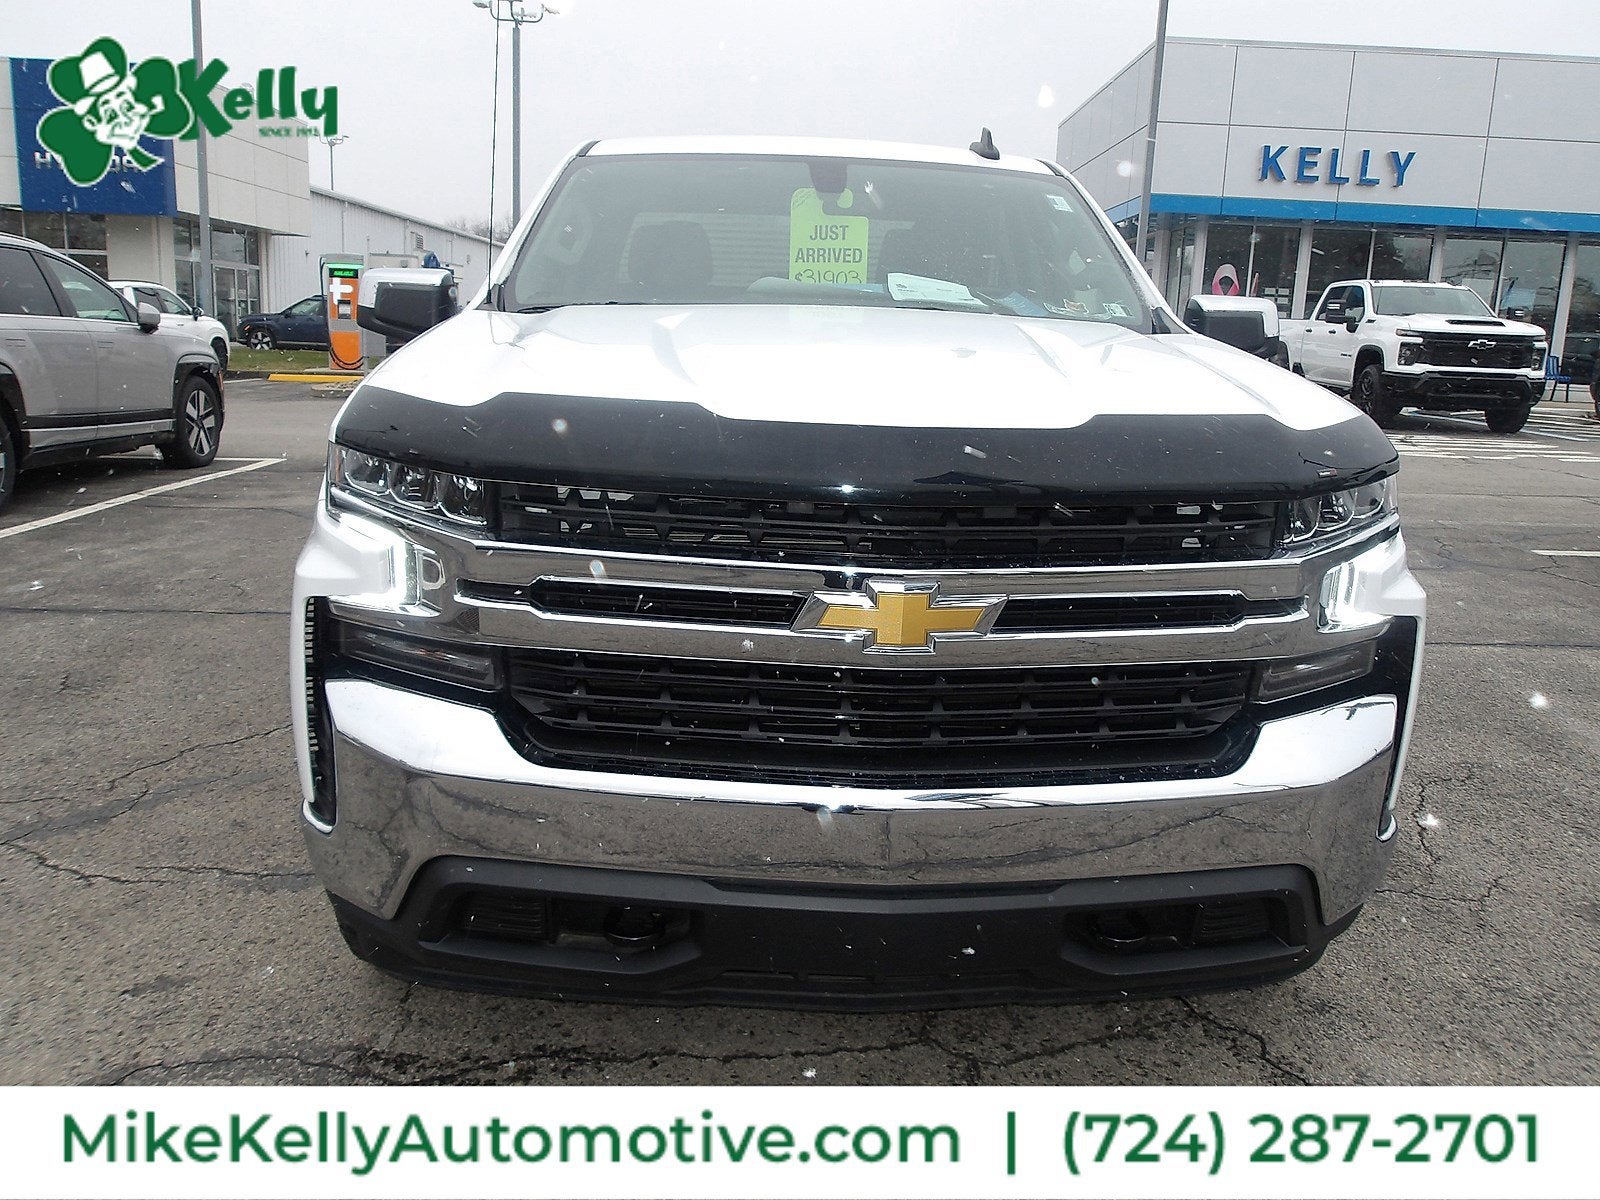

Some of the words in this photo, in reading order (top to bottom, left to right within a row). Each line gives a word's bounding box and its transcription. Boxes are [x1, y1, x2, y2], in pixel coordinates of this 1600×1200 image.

[1258, 144, 1417, 188] KELLY
[809, 224, 849, 241] JUST
[794, 247, 863, 264] ARRIVED
[794, 268, 863, 284] $31903
